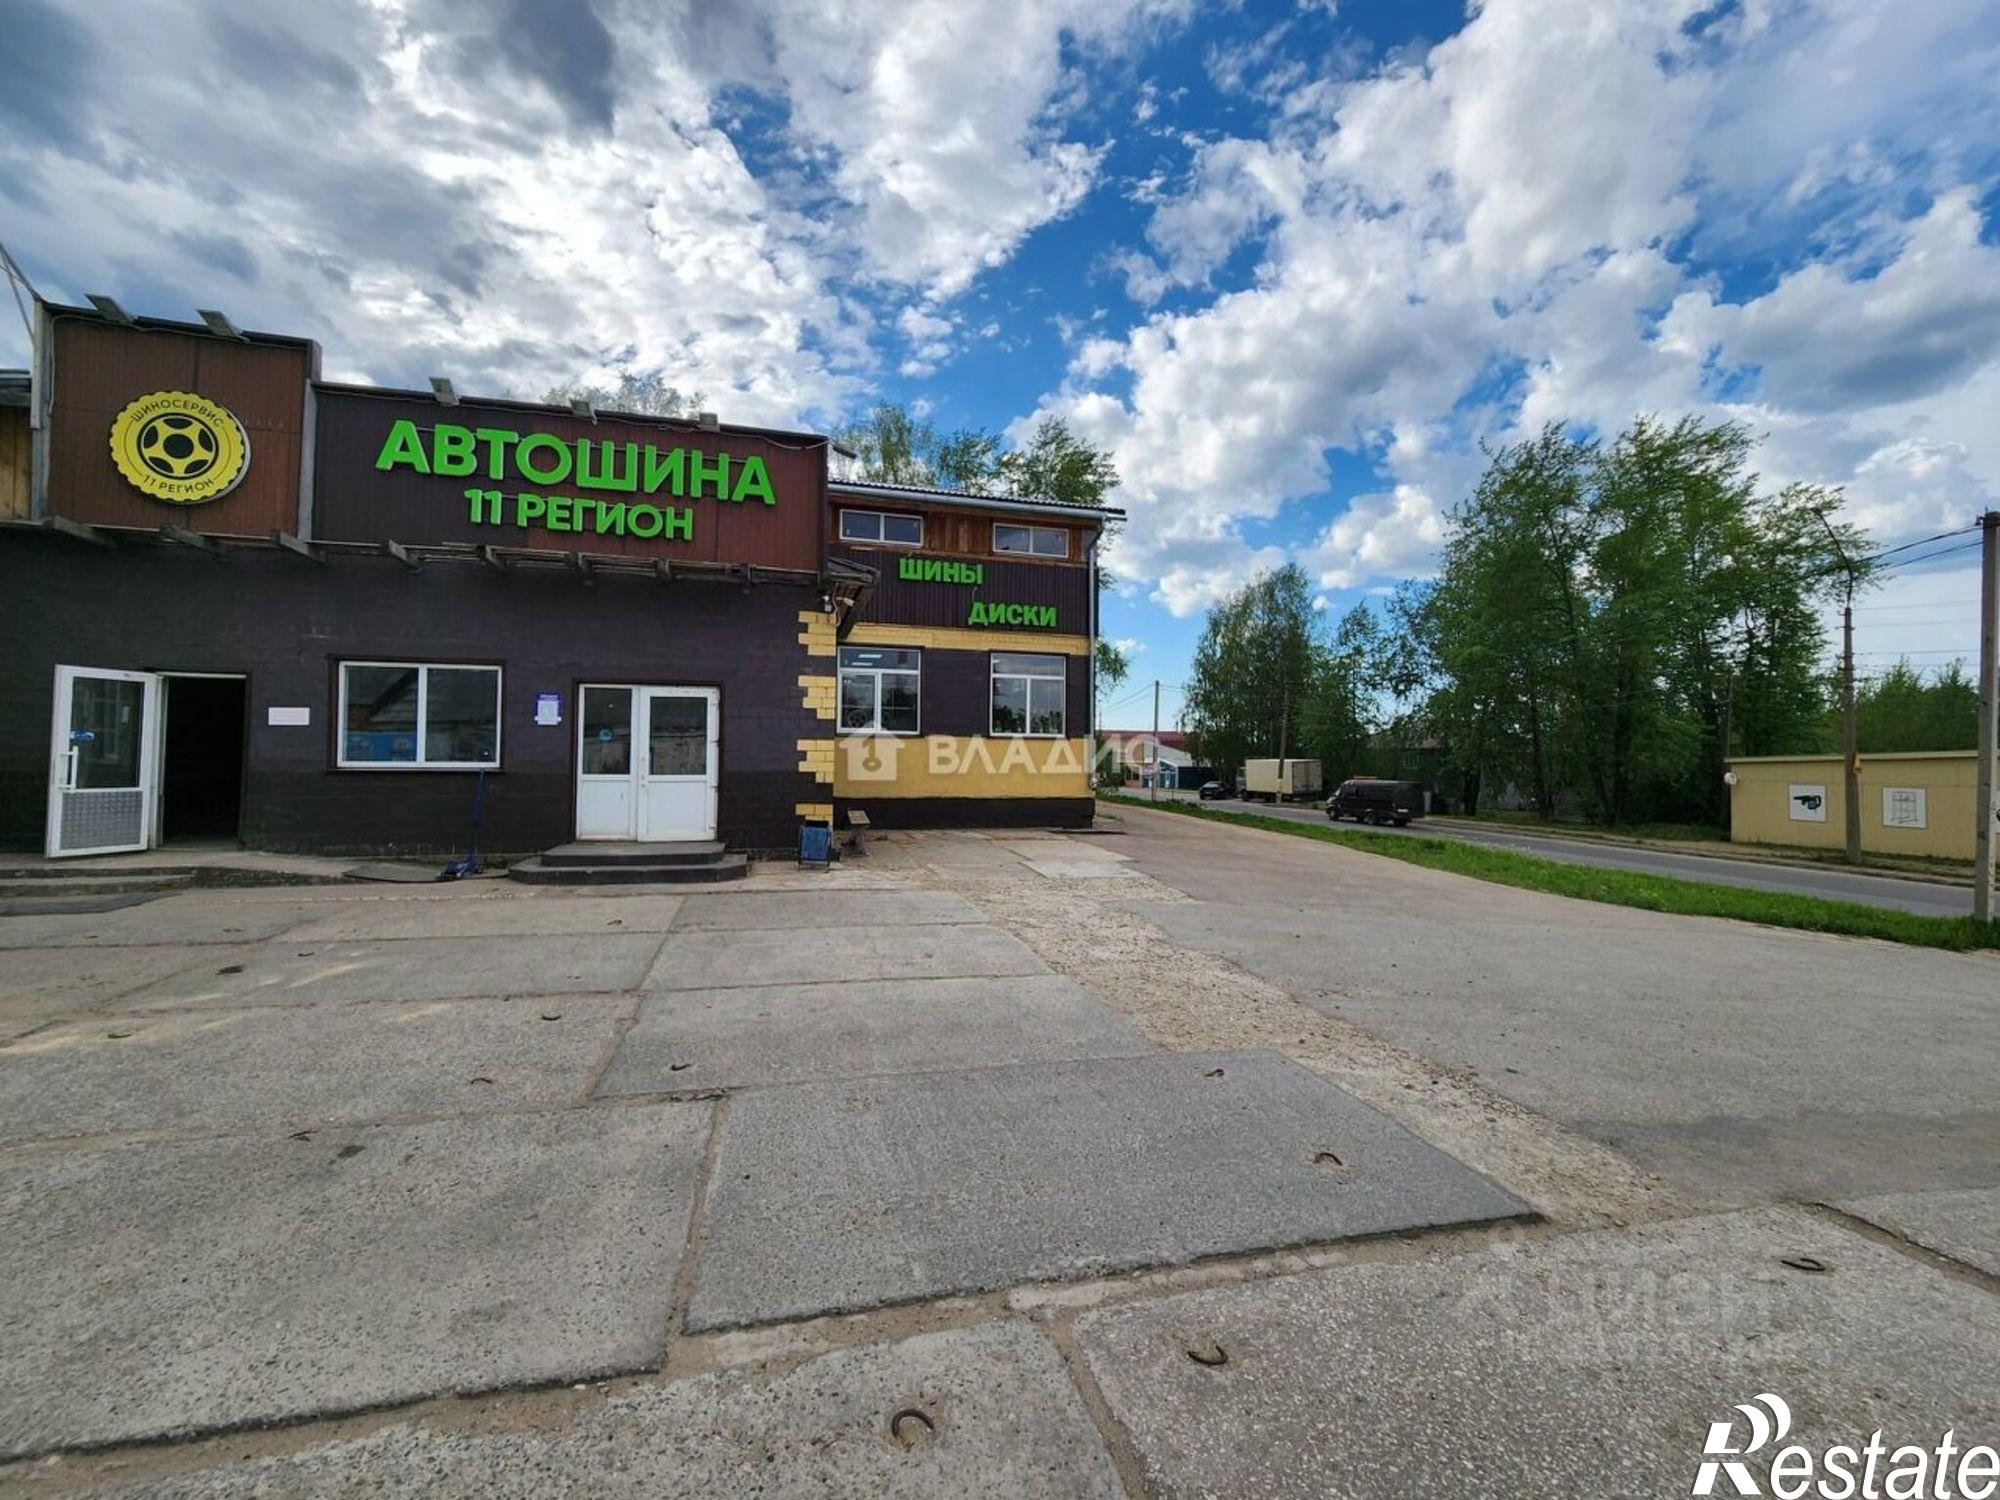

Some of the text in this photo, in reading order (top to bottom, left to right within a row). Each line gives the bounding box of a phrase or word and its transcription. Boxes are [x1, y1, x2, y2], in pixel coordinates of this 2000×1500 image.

[131, 399, 224, 427] ШИНОСЕРВИС
[375, 420, 776, 505] АВТОШИНА
[143, 474, 214, 493] 11 РЕГИОН
[464, 488, 693, 540] 11 РЕГИОН
[899, 557, 983, 585] ШИНЫ
[968, 601, 1057, 627] ДИСКИ
